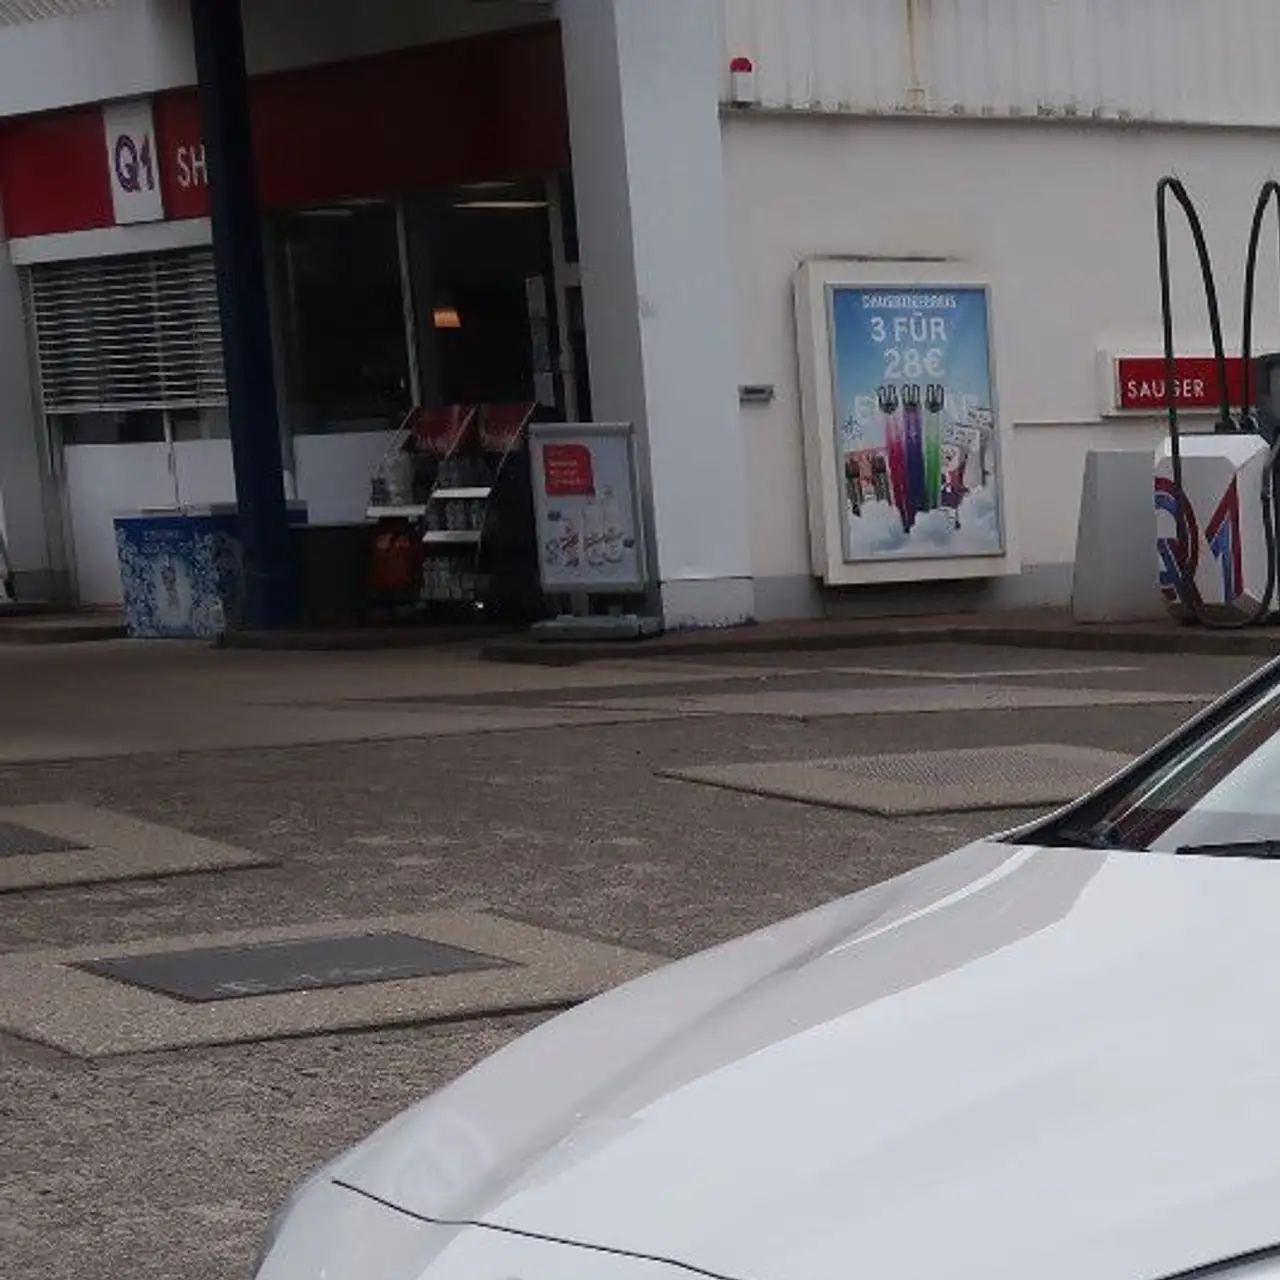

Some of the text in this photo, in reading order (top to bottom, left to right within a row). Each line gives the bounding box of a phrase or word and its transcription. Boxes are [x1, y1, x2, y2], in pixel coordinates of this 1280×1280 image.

[115, 134, 154, 193] Q1
[871, 311, 947, 342] 3 FÜR
